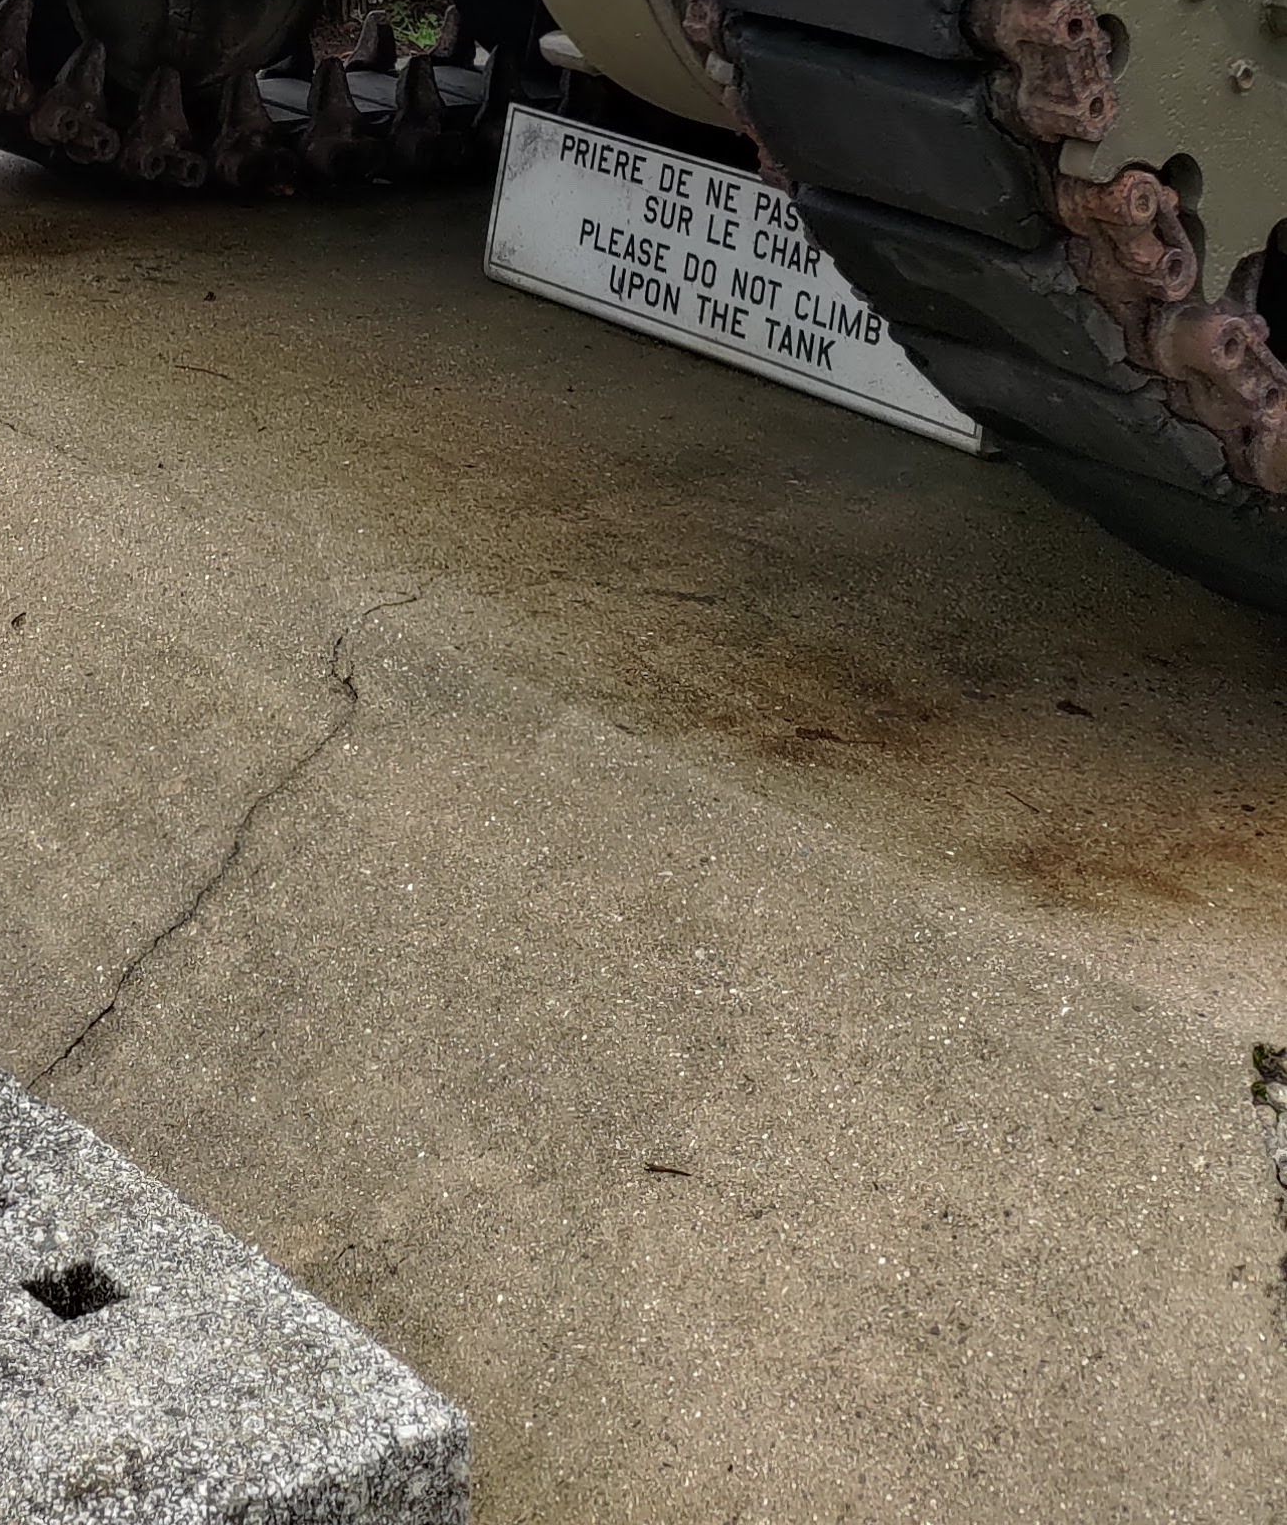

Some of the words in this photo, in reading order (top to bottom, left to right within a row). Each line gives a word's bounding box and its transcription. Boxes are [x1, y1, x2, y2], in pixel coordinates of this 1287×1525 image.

[644, 195, 694, 237] SUR
[706, 213, 740, 251] LE
[753, 229, 821, 278] CHAR
[659, 163, 694, 200] DE
[706, 176, 742, 214] NE
[754, 191, 800, 233] PAS
[579, 217, 671, 274] PLEASE
[683, 251, 717, 290] DO
[730, 267, 783, 311] NOT
[794, 289, 882, 346] CLIMB
[609, 264, 681, 316] UPON
[696, 293, 750, 340] THE
[764, 316, 837, 371] TANK
